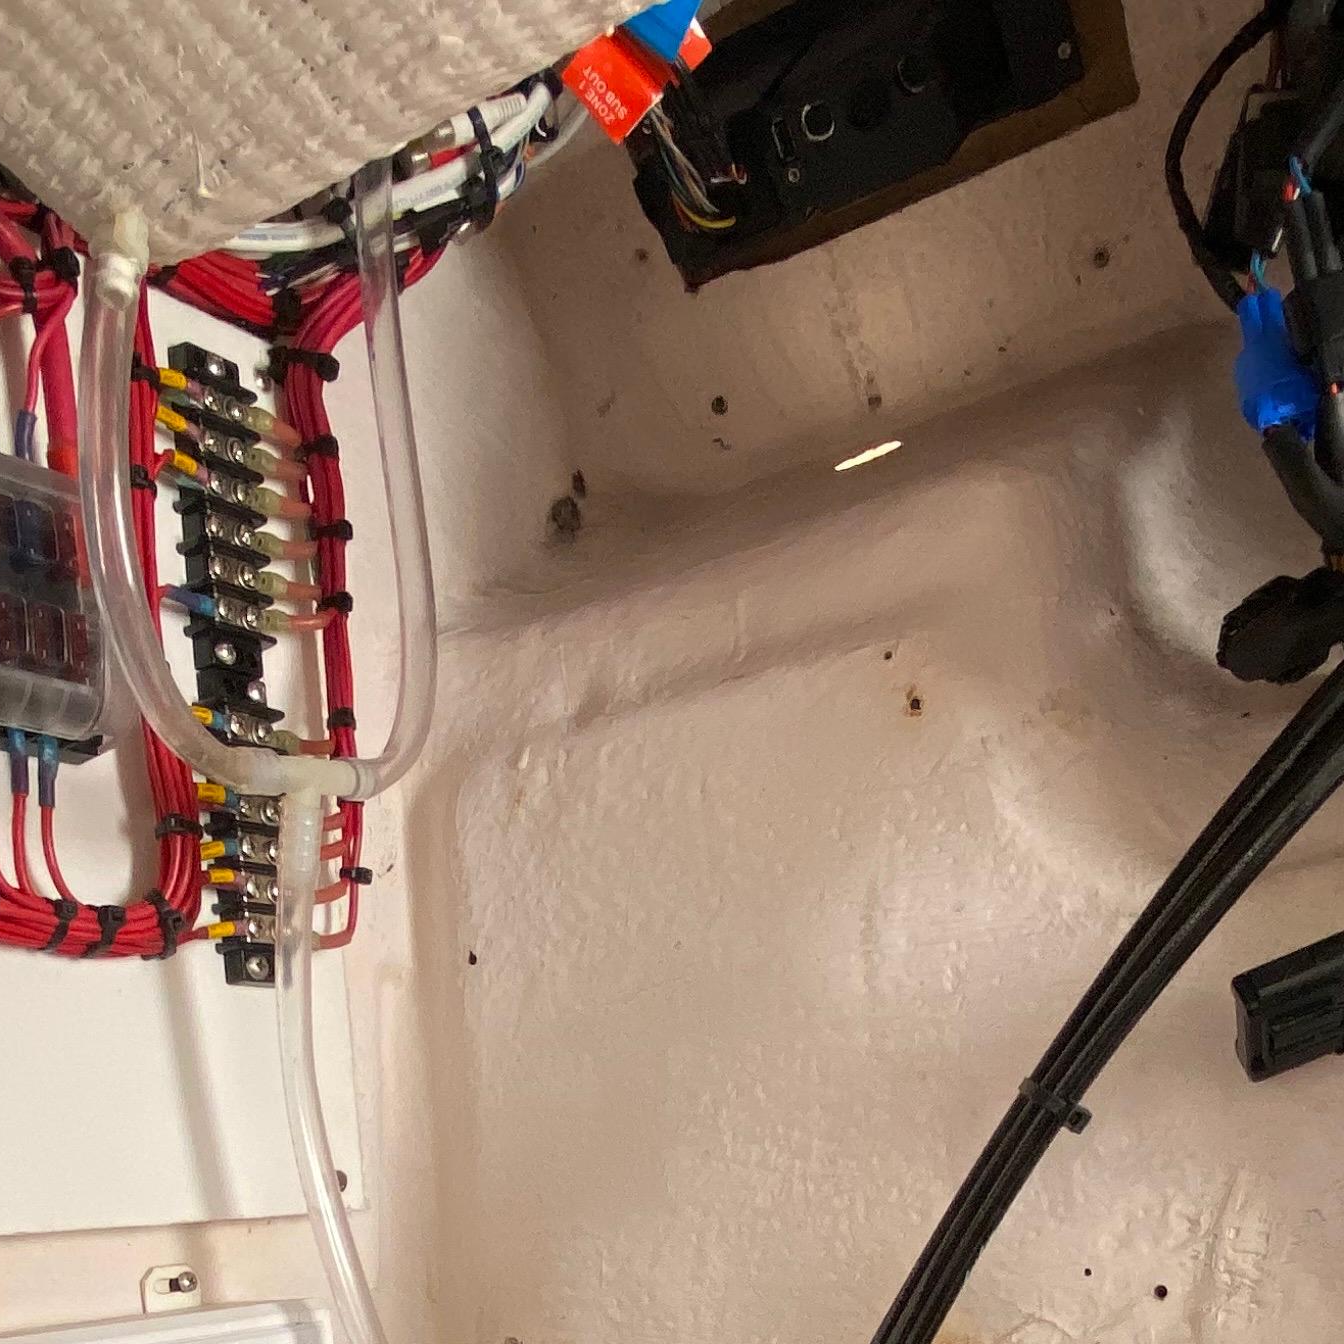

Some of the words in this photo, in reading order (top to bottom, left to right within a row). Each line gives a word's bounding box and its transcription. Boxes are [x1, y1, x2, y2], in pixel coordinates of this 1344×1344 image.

[582, 65, 607, 94] OUT
[584, 88, 616, 126] ZONE
[605, 91, 628, 120] SUB
